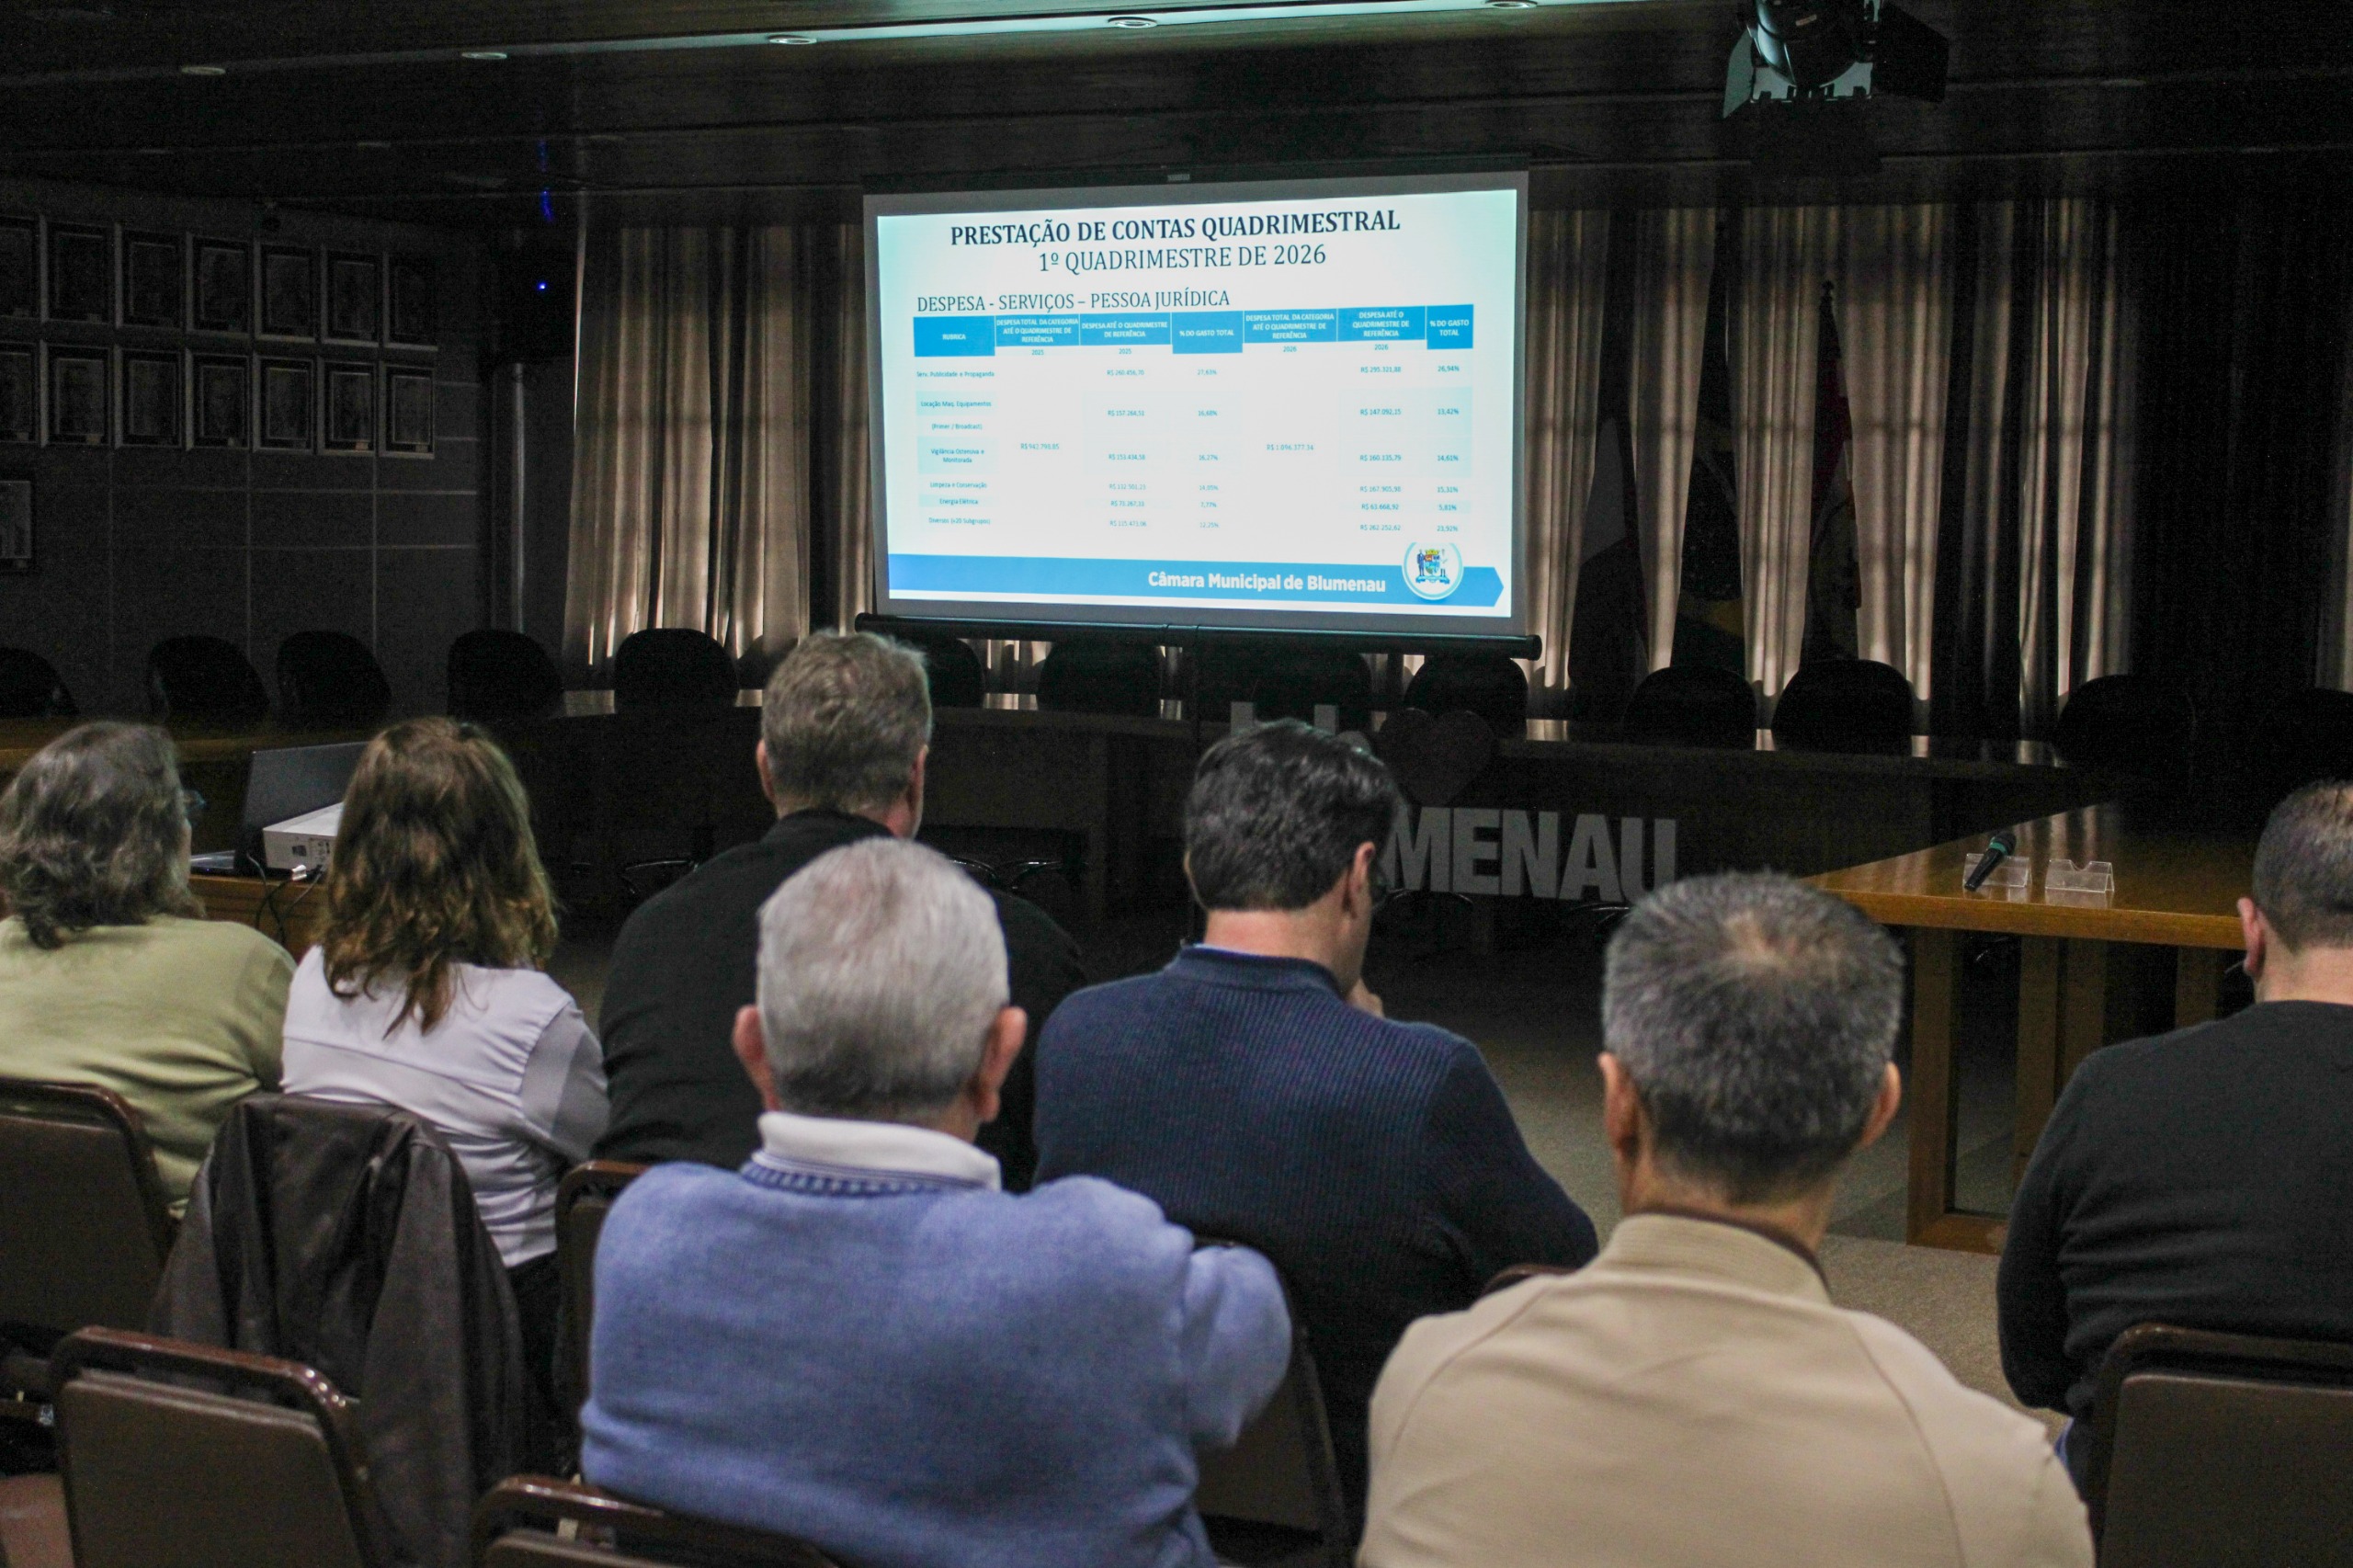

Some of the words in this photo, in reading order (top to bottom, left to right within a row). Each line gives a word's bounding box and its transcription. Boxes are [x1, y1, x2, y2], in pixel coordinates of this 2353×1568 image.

[950, 219, 1070, 247] PRESTAÇÃO
[1077, 222, 1106, 241] DE
[1112, 218, 1195, 240] CONTAS
[1201, 210, 1401, 241] QUADRIMESTRAL
[1040, 252, 1059, 271] 1º
[1065, 247, 1231, 275] QUADRIMESTRE
[1238, 245, 1267, 266] DE
[1274, 244, 1326, 265] 2026
[917, 296, 985, 312] DESPESA
[998, 293, 1074, 313] SERVIÇOS
[1091, 291, 1151, 309] PESSOA
[1155, 287, 1230, 311] JURÍDICA
[1385, 310, 1397, 318] ATÉ
[1105, 321, 1117, 329] ATÉ
[1253, 323, 1264, 331] ATÉ
[1003, 326, 1014, 335] ATÉ
[1113, 329, 1145, 337] REFERÊNCIA
[1363, 329, 1399, 337] REFERÊNCIA
[1272, 331, 1307, 339] REFERÊNCIA
[1148, 571, 1205, 587] Câmara
[1208, 573, 1280, 591] Municipal
[1284, 575, 1303, 590] de
[1307, 575, 1386, 593] Blumenau
[1381, 806, 1677, 903] MENAU
